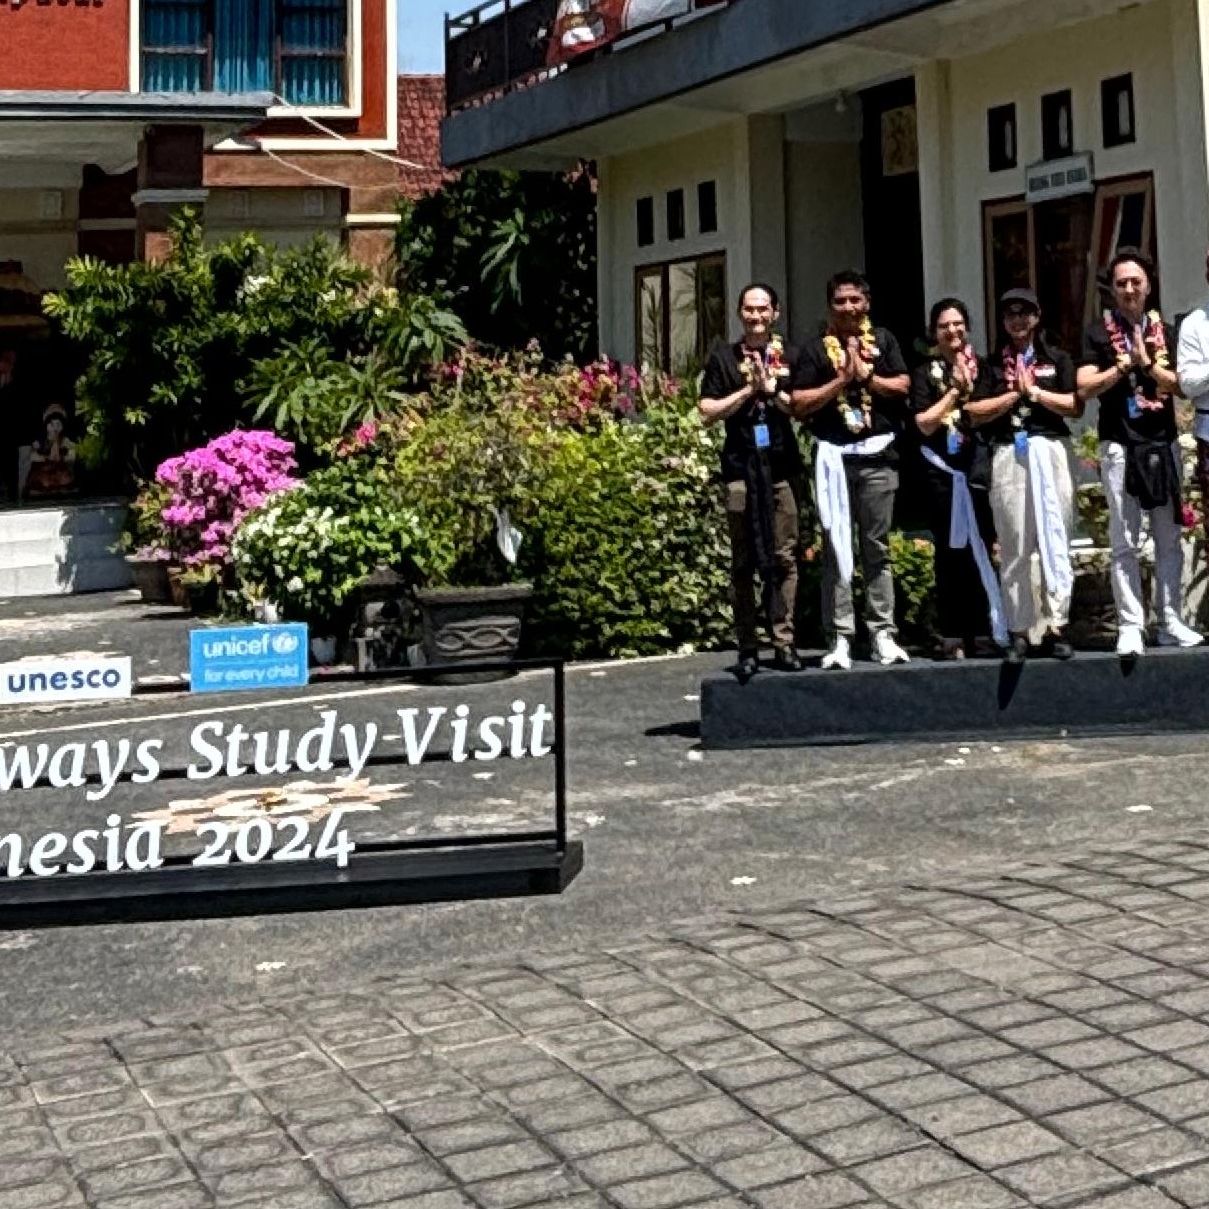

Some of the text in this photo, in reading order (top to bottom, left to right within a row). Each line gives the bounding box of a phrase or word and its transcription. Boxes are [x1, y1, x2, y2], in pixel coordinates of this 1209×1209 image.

[203, 632, 271, 658] unicef
[8, 668, 121, 693] unesco
[204, 663, 299, 683] for every child
[187, 709, 378, 781] Study
[396, 699, 552, 765] Visit
[192, 806, 356, 868] 2024
